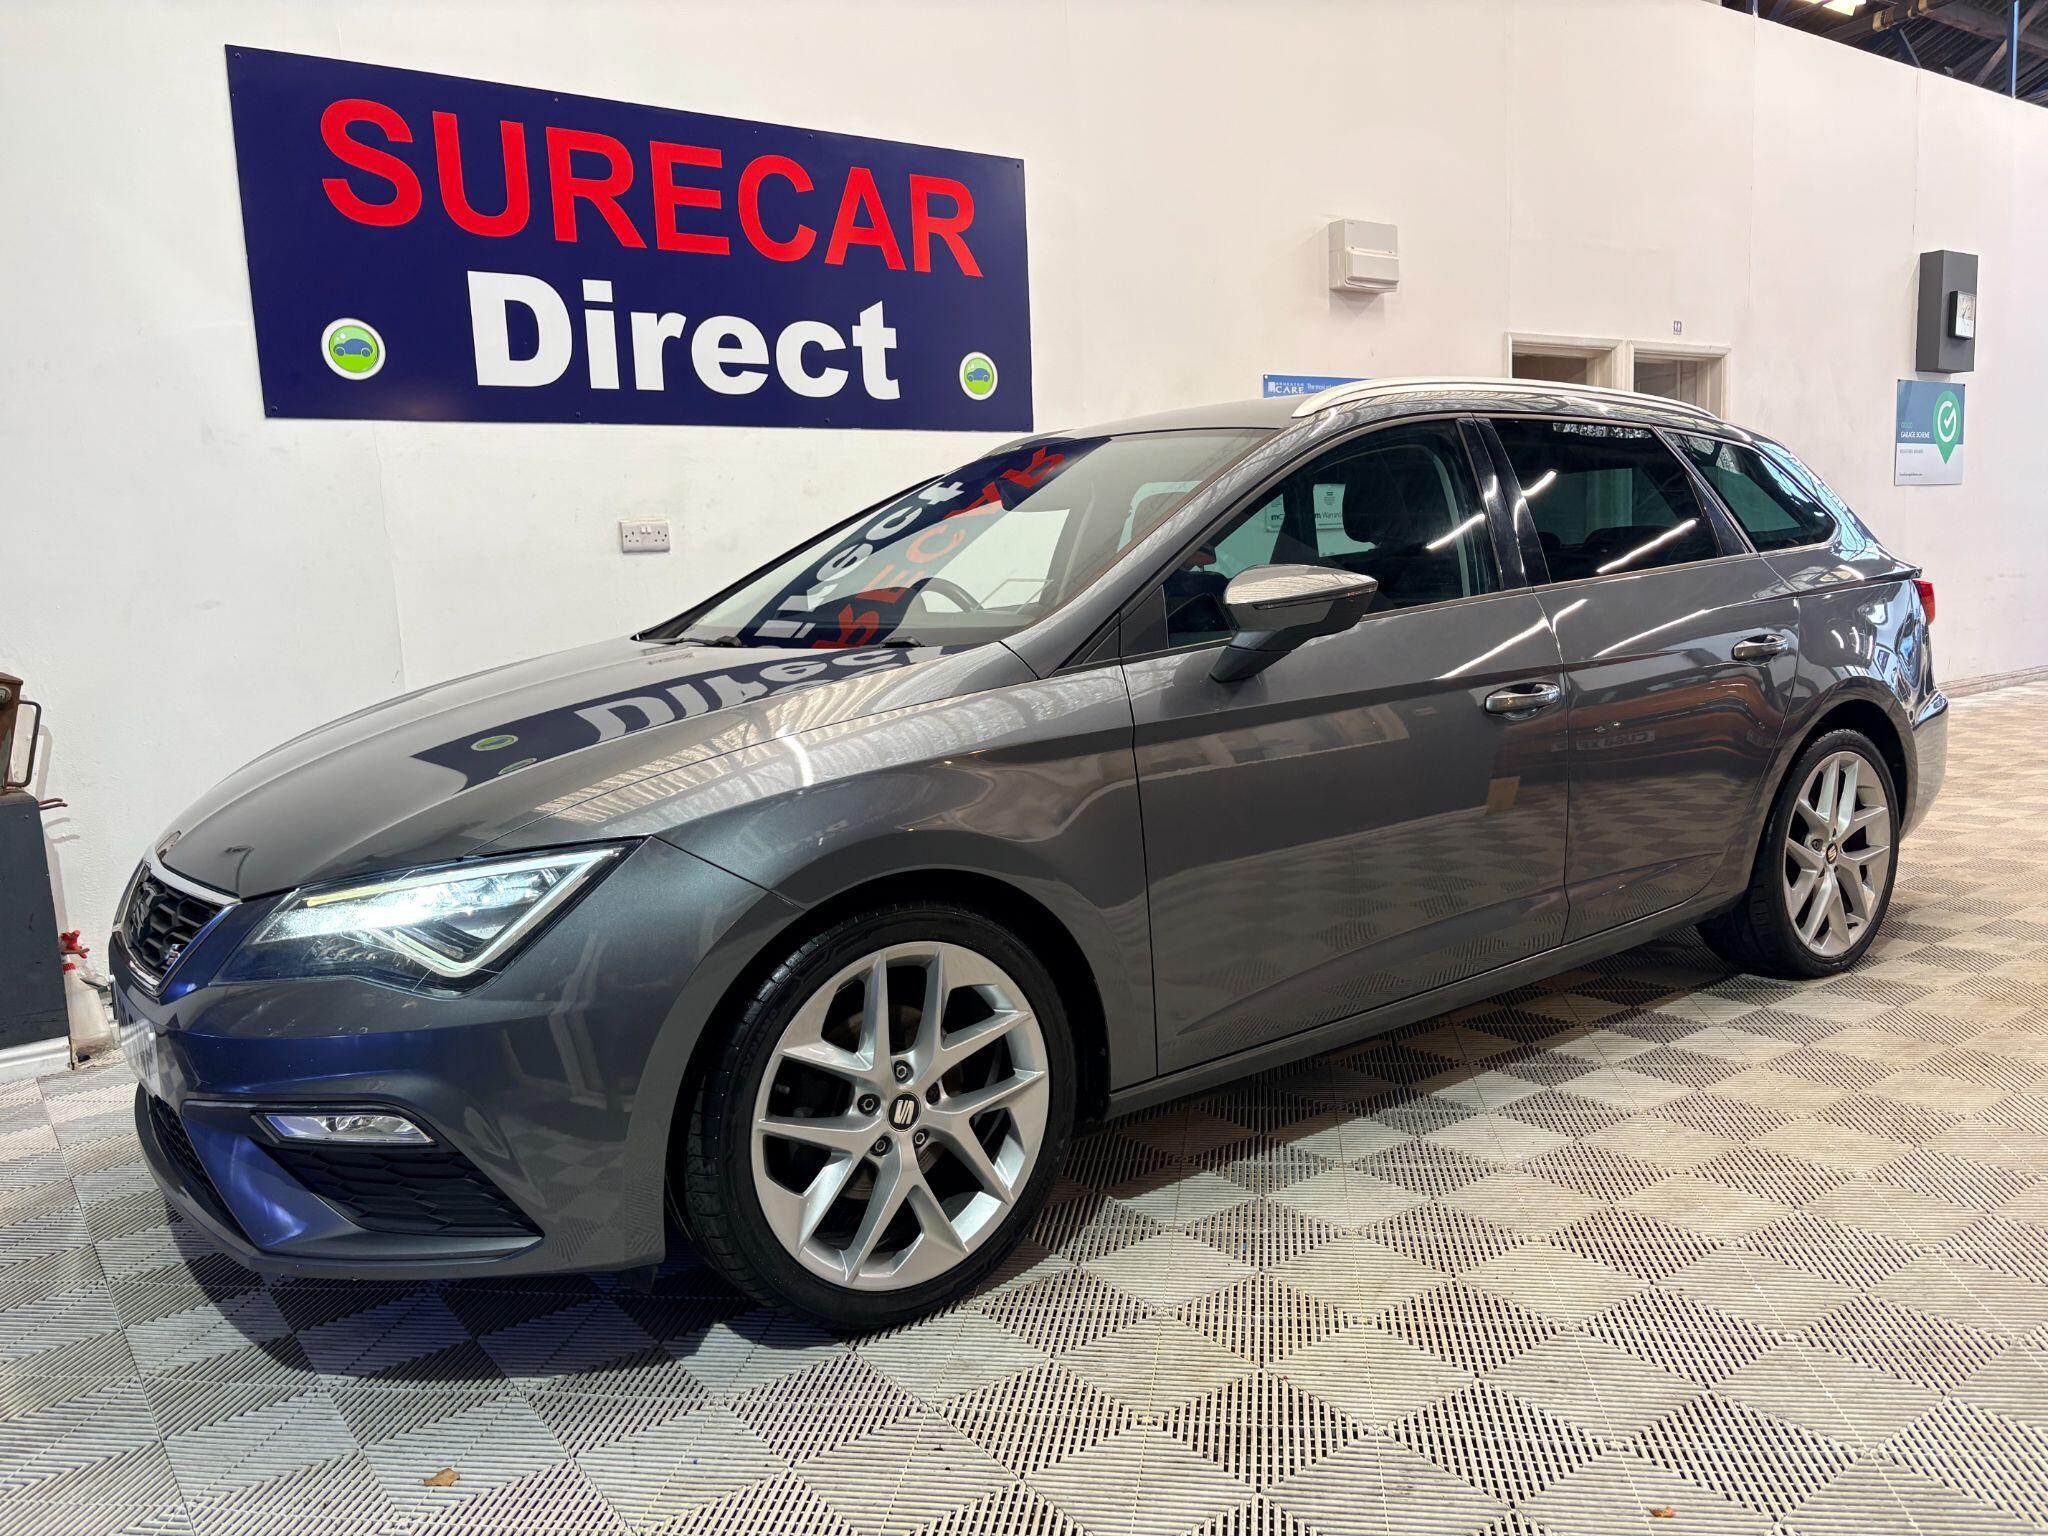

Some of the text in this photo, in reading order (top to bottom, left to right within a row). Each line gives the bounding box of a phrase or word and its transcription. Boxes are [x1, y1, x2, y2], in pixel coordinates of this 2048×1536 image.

[320, 98, 984, 278] SURECAR
[467, 270, 901, 400] Direct
[1275, 386, 1305, 394] CARE
